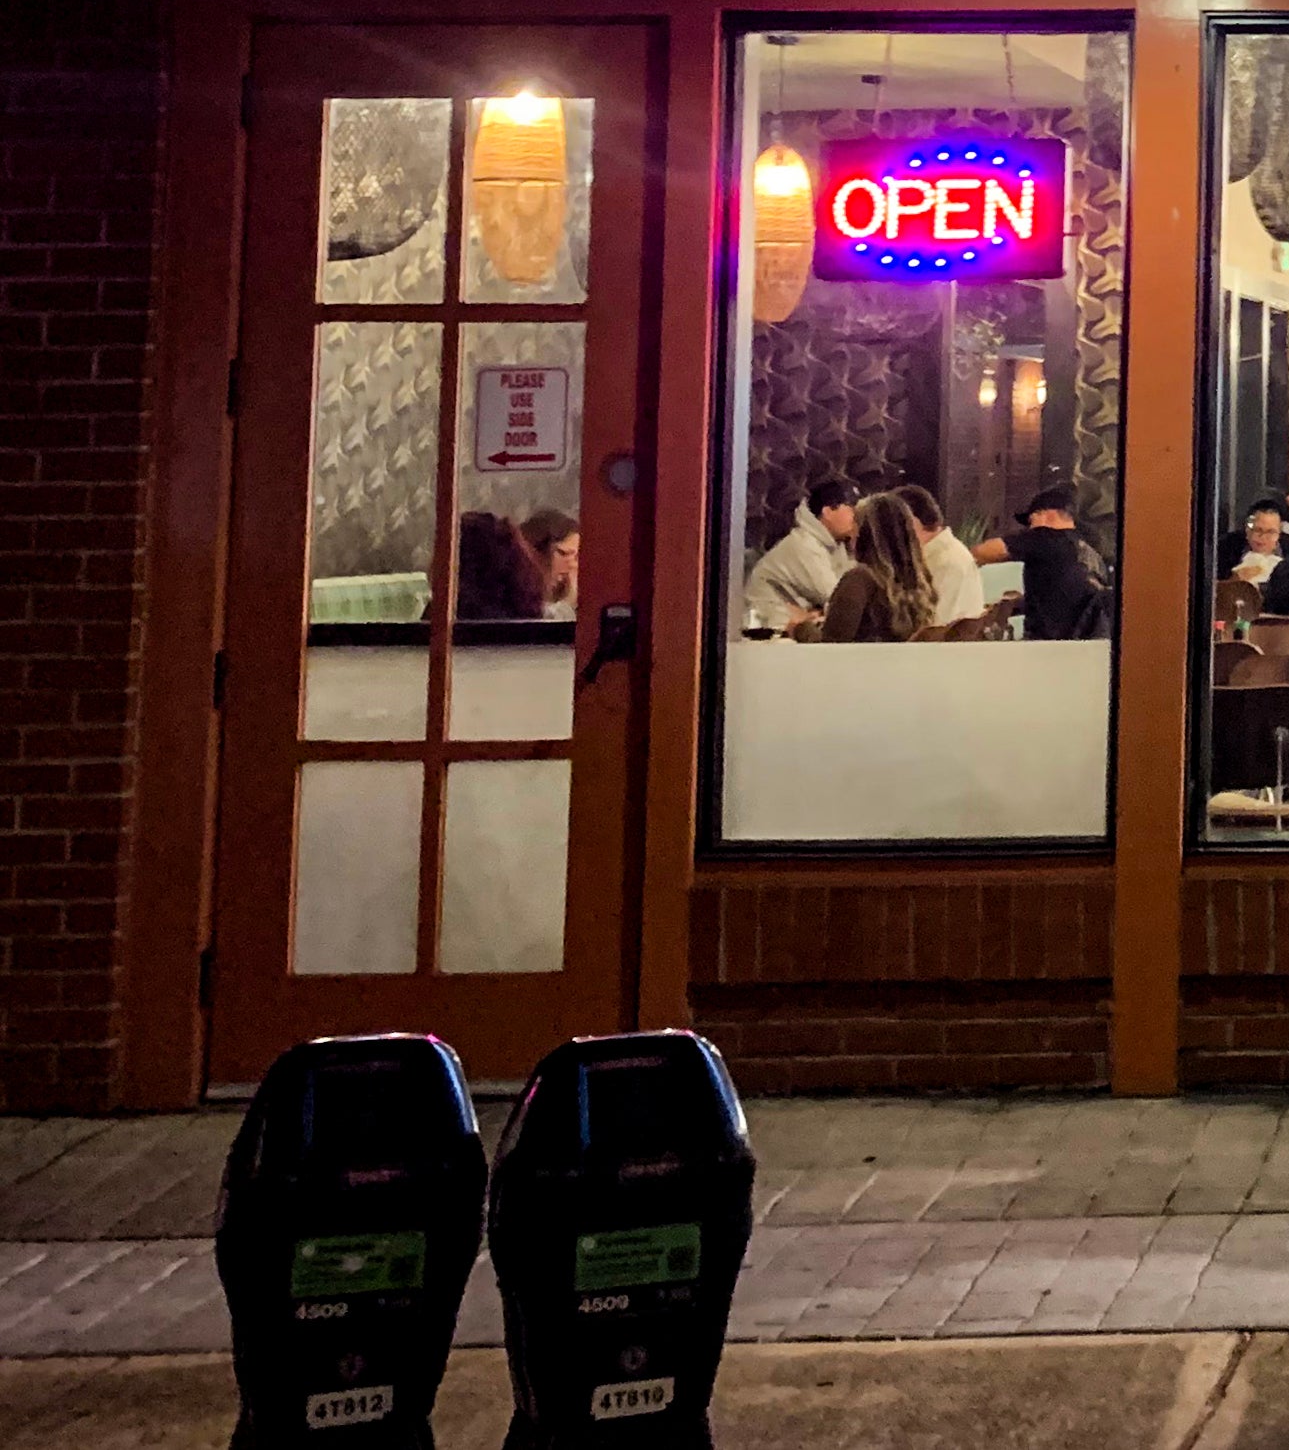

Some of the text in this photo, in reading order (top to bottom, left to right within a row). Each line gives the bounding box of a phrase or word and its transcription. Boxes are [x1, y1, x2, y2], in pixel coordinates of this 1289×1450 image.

[832, 177, 1035, 239] OPEN
[501, 372, 545, 388] PLEASE
[510, 392, 534, 408] USE
[508, 412, 534, 427] SIDE
[504, 431, 538, 447] DOOR
